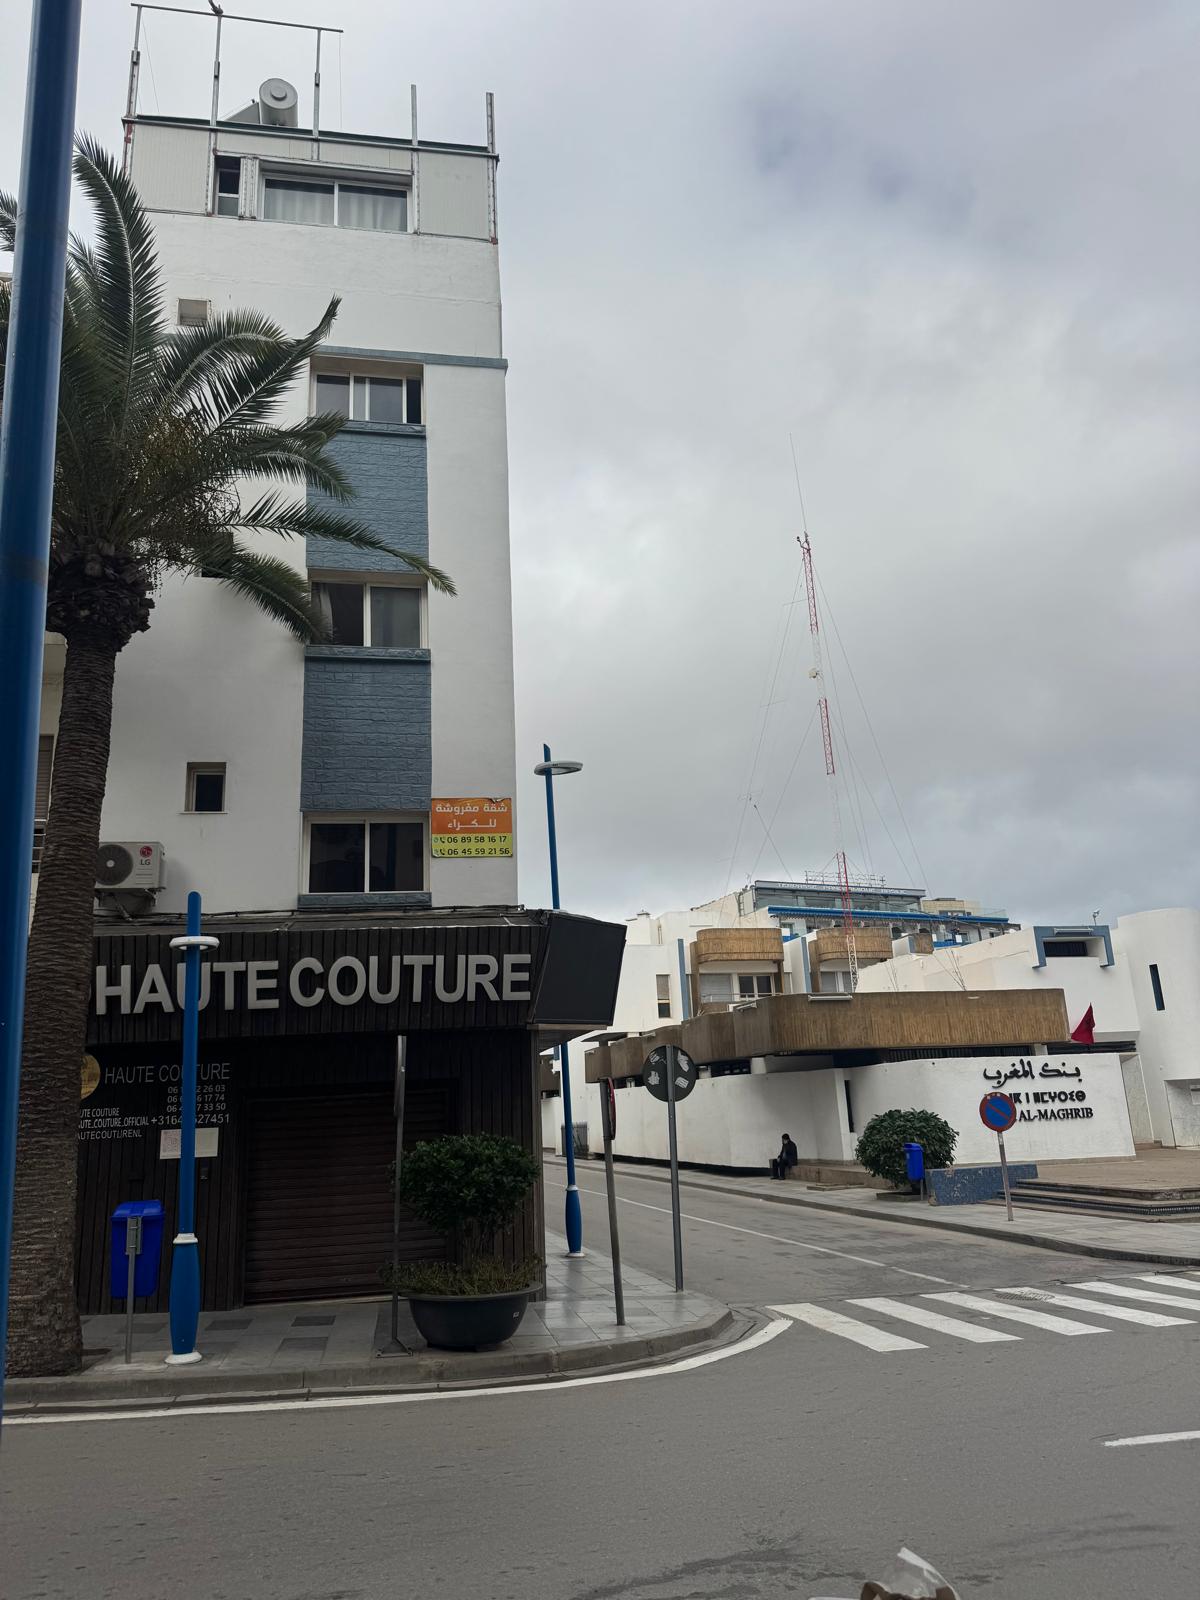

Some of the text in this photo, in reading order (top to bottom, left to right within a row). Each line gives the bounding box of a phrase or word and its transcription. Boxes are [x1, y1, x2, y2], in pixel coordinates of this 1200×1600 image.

[435, 802, 508, 816] شقة مفروشة
[446, 836, 458, 844] 06
[499, 835, 507, 843] 17
[447, 848, 459, 856] 06
[461, 848, 472, 856] 45
[95, 953, 532, 1016] HAUTE COUTURE
[104, 1065, 155, 1085] HAUTE
[158, 1062, 231, 1082] COURE
[982, 1058, 1083, 1089] بنك المغرب
[167, 1086, 178, 1094] 06
[202, 1085, 214, 1093] 26
[215, 1084, 225, 1092] 03
[167, 1095, 177, 1103] 06
[204, 1094, 213, 1102] 17
[214, 1093, 225, 1101] 74
[79, 1107, 120, 1119] UTE COUTURE
[203, 1103, 214, 1111] 33
[215, 1103, 226, 1111] 50
[150, 1113, 230, 1126] +316427451
[1018, 1107, 1094, 1123] AL-MAGHRIB
